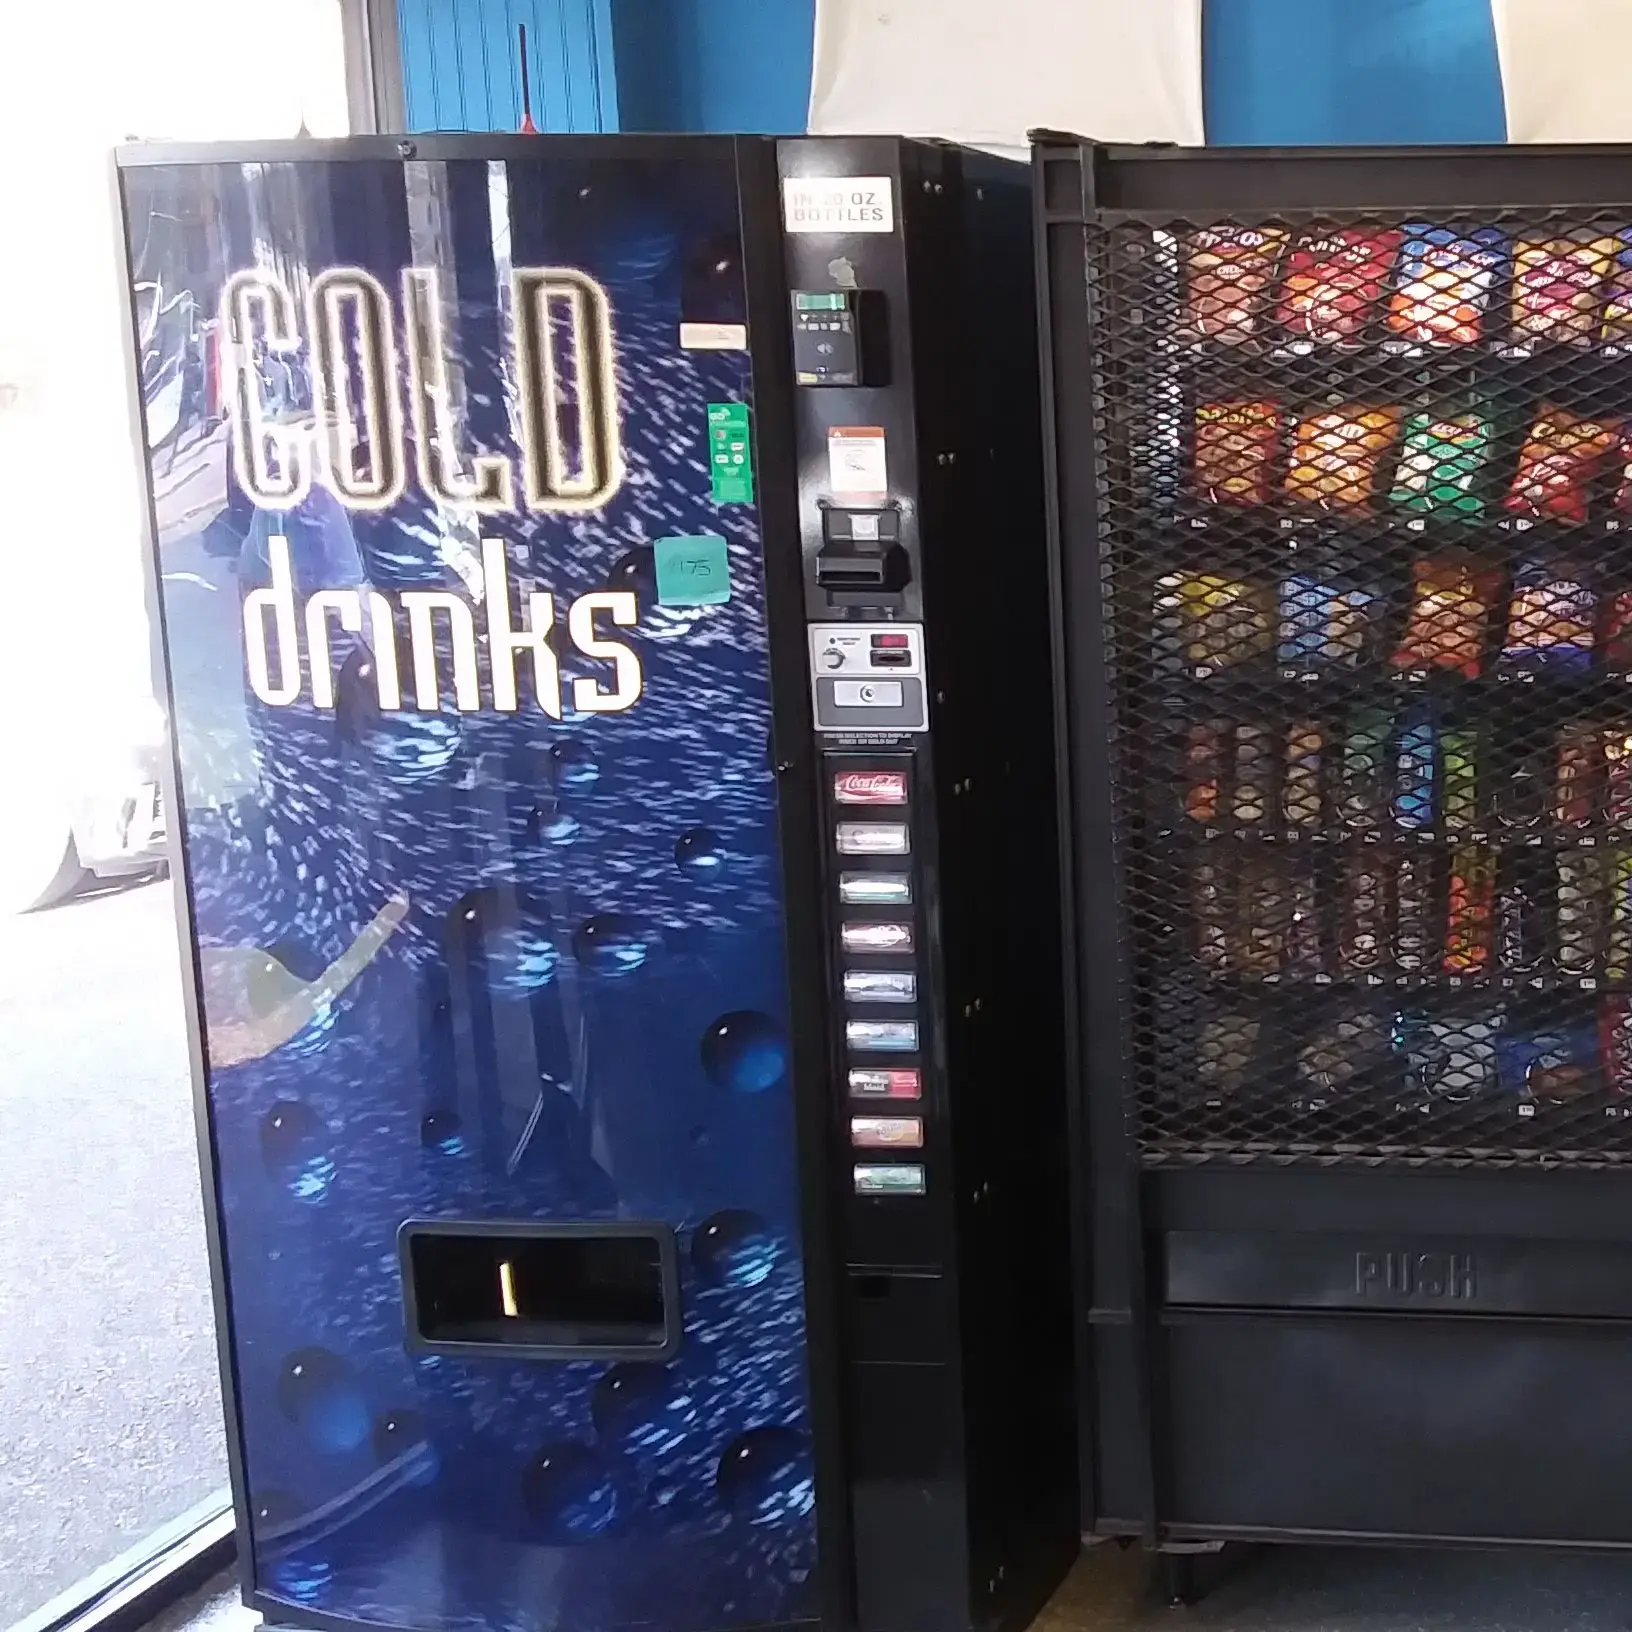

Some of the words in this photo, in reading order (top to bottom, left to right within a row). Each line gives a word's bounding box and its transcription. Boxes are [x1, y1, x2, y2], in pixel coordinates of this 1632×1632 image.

[794, 208, 884, 221] BOTTLES
[220, 267, 622, 511] COLD
[243, 537, 643, 719] drinks
[1355, 1251, 1479, 1299] PUSH
